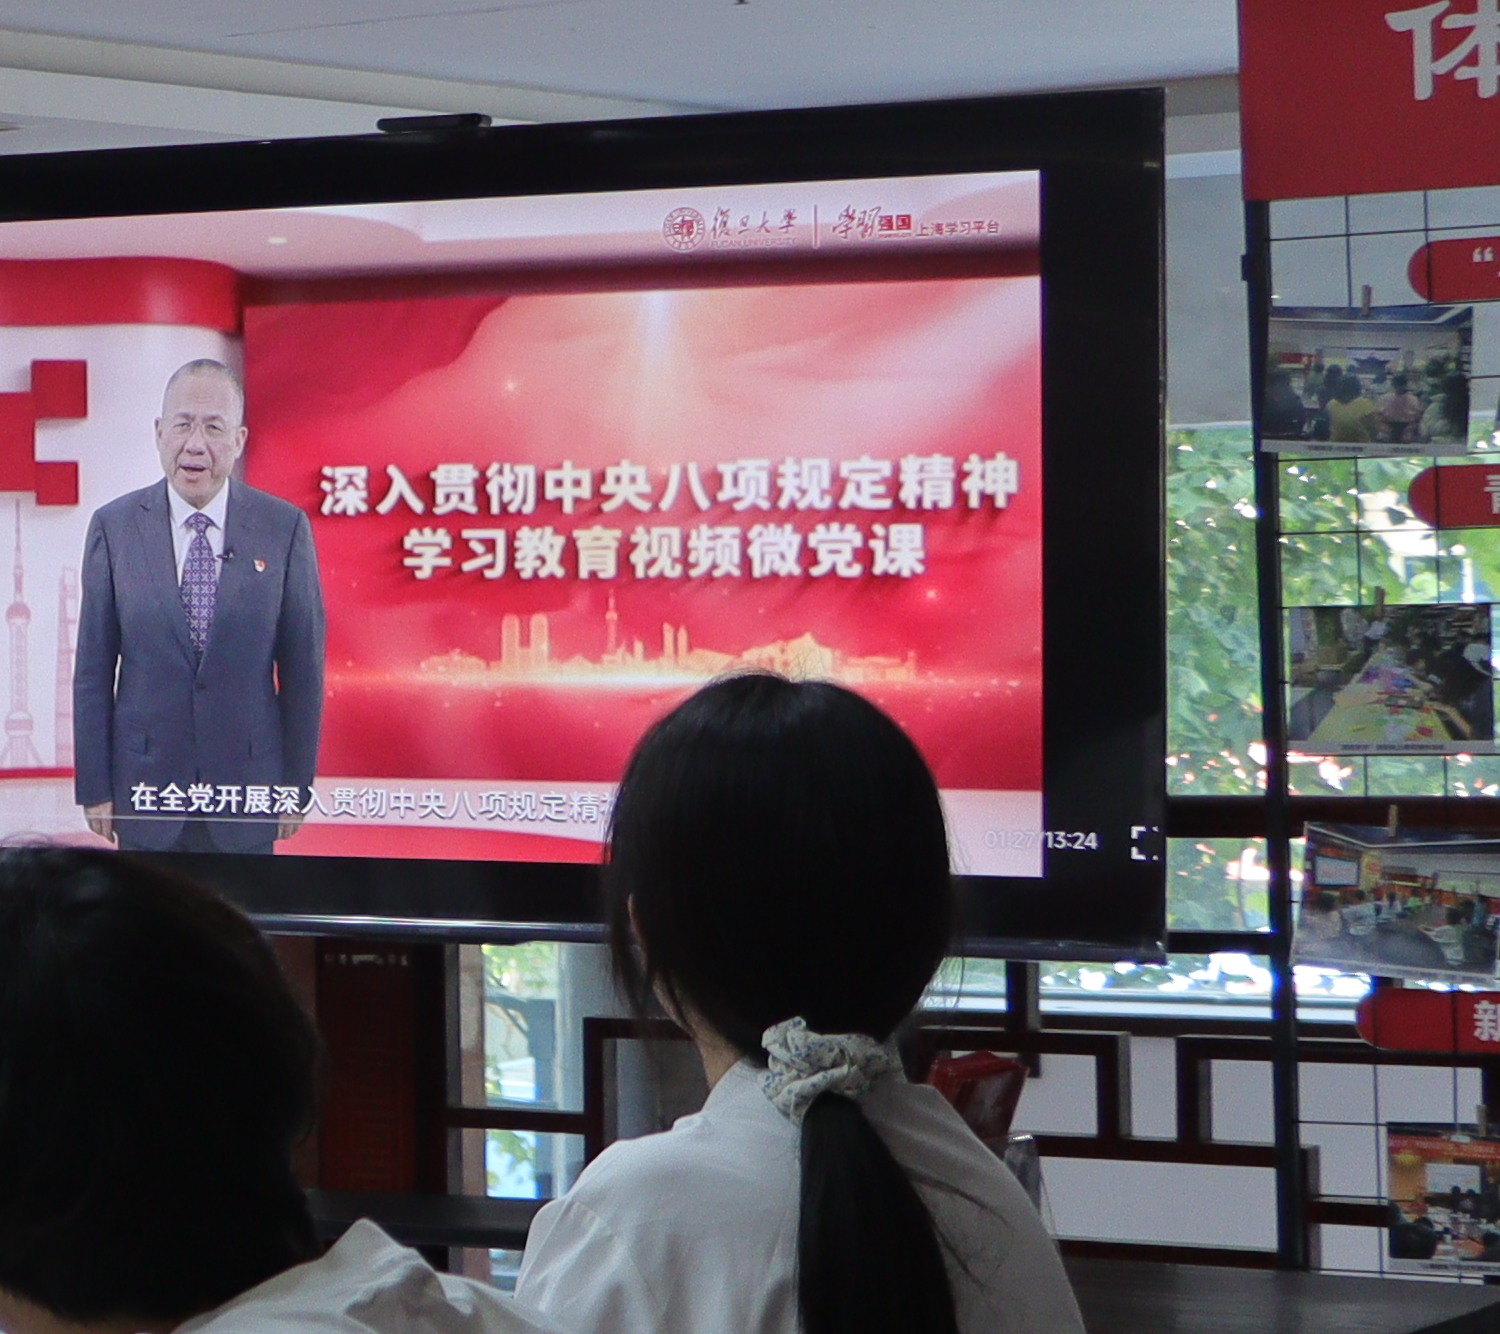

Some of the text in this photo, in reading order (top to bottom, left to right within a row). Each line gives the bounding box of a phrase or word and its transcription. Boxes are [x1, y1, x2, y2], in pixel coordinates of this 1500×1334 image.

[916, 219, 1000, 238] 上海学习平台
[319, 451, 1020, 517] 深入贯彻中央八项规定精神
[403, 523, 927, 581] 学习教育视频微党课
